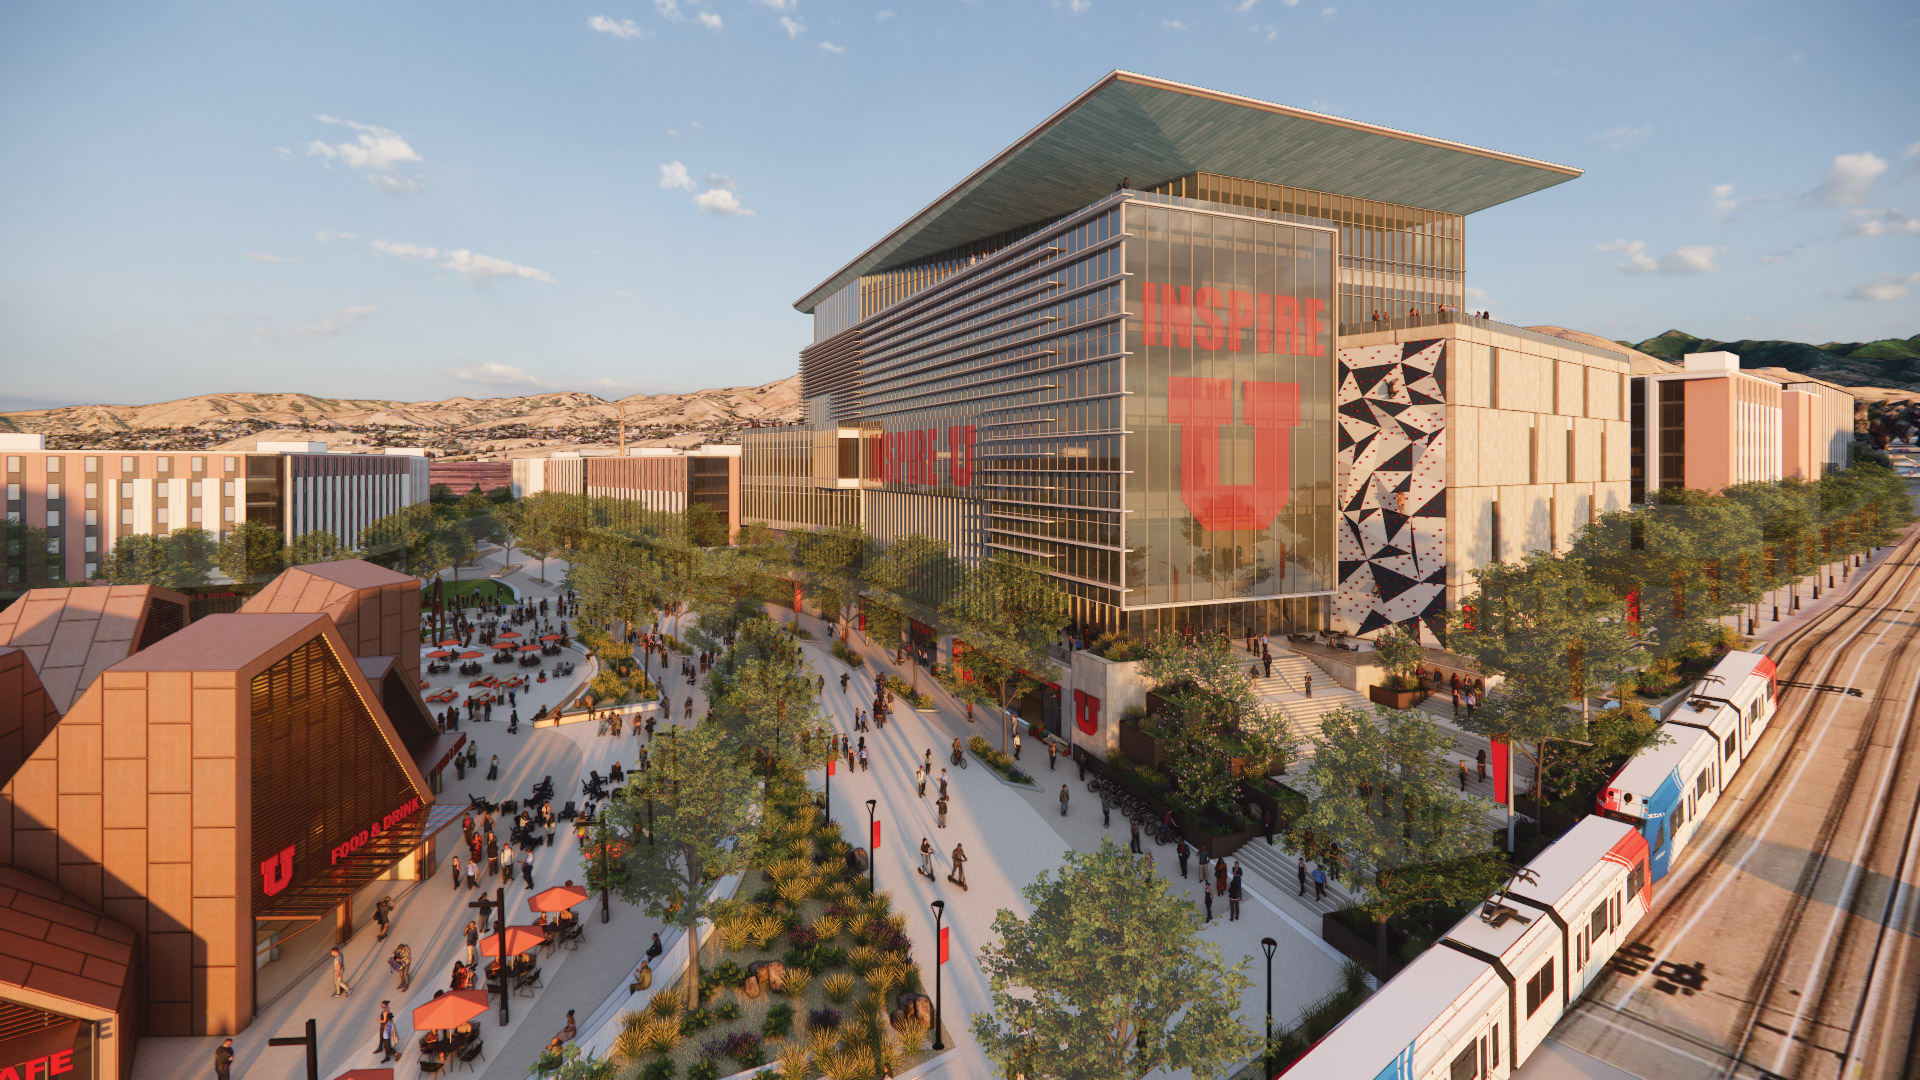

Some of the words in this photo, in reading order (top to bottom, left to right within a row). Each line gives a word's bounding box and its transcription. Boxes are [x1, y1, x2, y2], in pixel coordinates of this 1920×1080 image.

[1142, 281, 1325, 357] INSPIRE
[869, 428, 938, 486] INSPIRE
[948, 424, 977, 488] U
[1168, 376, 1301, 532] U
[1074, 688, 1100, 736] U
[331, 830, 369, 865] FOOD
[371, 822, 382, 838] &
[383, 796, 420, 831] DRINK
[261, 843, 296, 896] U
